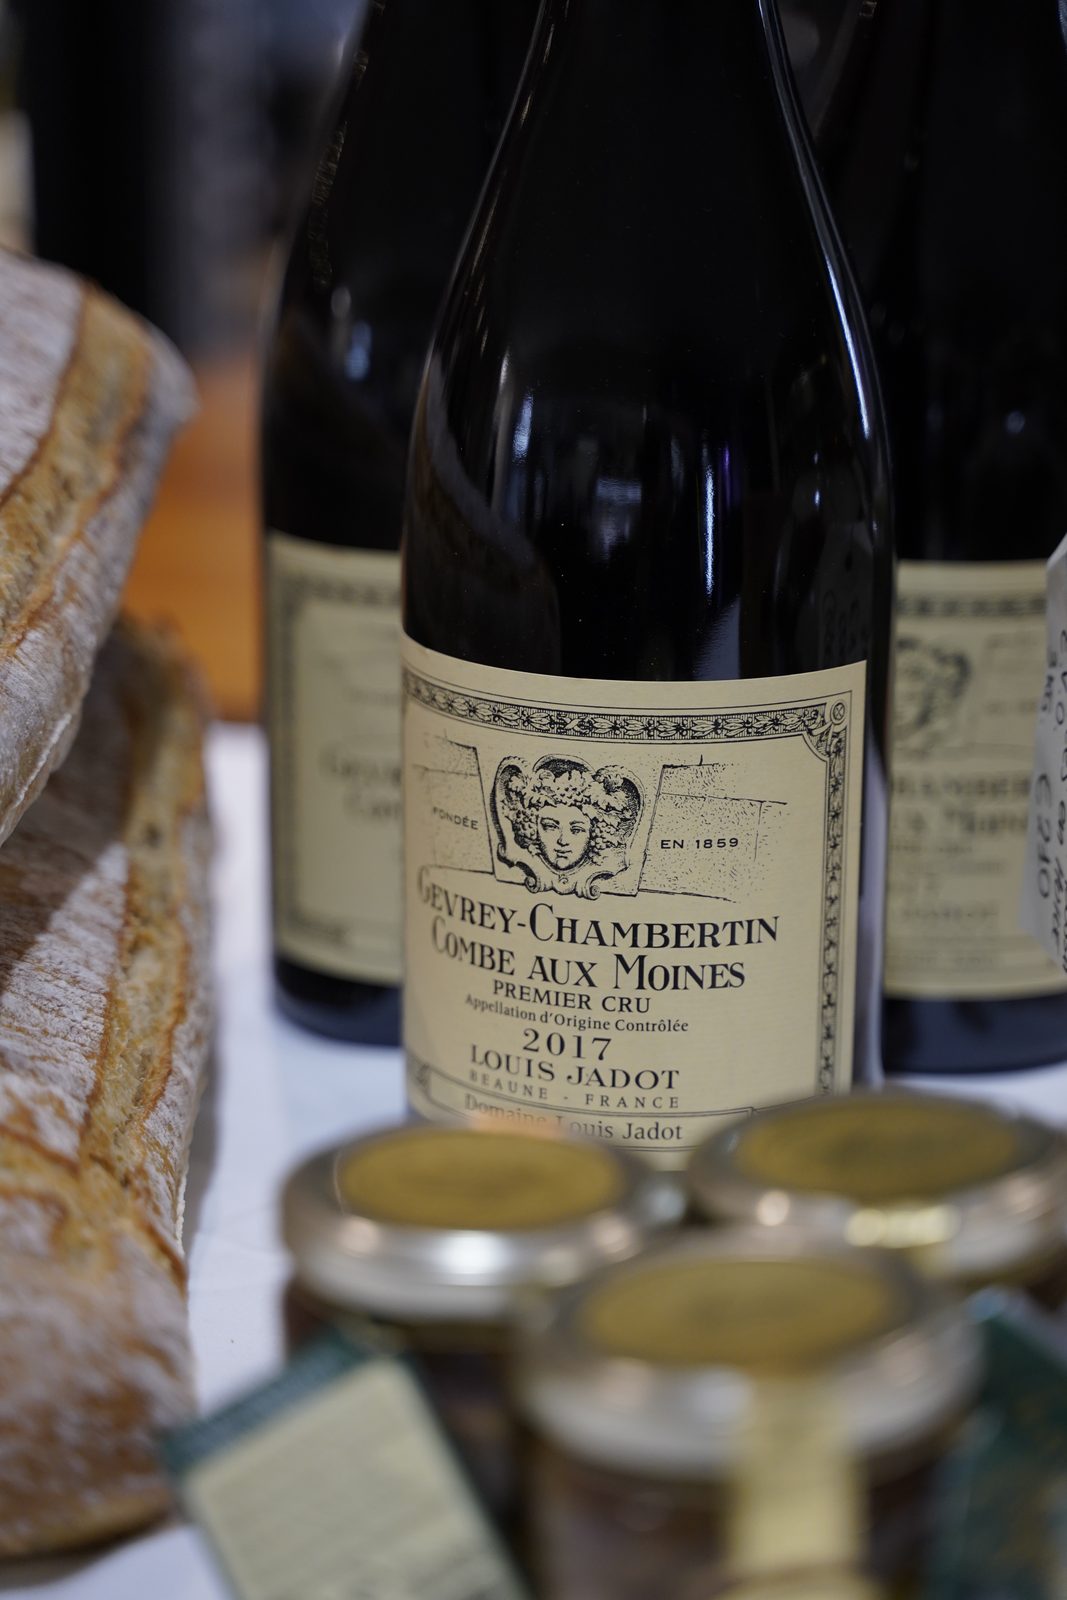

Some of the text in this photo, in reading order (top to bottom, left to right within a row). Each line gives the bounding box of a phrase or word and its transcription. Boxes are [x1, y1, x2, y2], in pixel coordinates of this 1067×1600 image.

[432, 805, 479, 831] FONDÉE
[660, 836, 739, 850] EN 1859
[417, 864, 780, 949] GEVREY-CHAMBERTIN
[432, 914, 746, 992] COMBE AUX MOINES
[465, 993, 690, 1033] Appellation d'Origine Contrôlée
[492, 979, 652, 1014] PREMIER CRU
[522, 1028, 613, 1062] 2017
[470, 1044, 680, 1091] LOUIS JADOT
[469, 1070, 549, 1100] BEAUNE
[584, 1093, 680, 1109] FRANCE
[622, 1121, 683, 1141] Jadot
